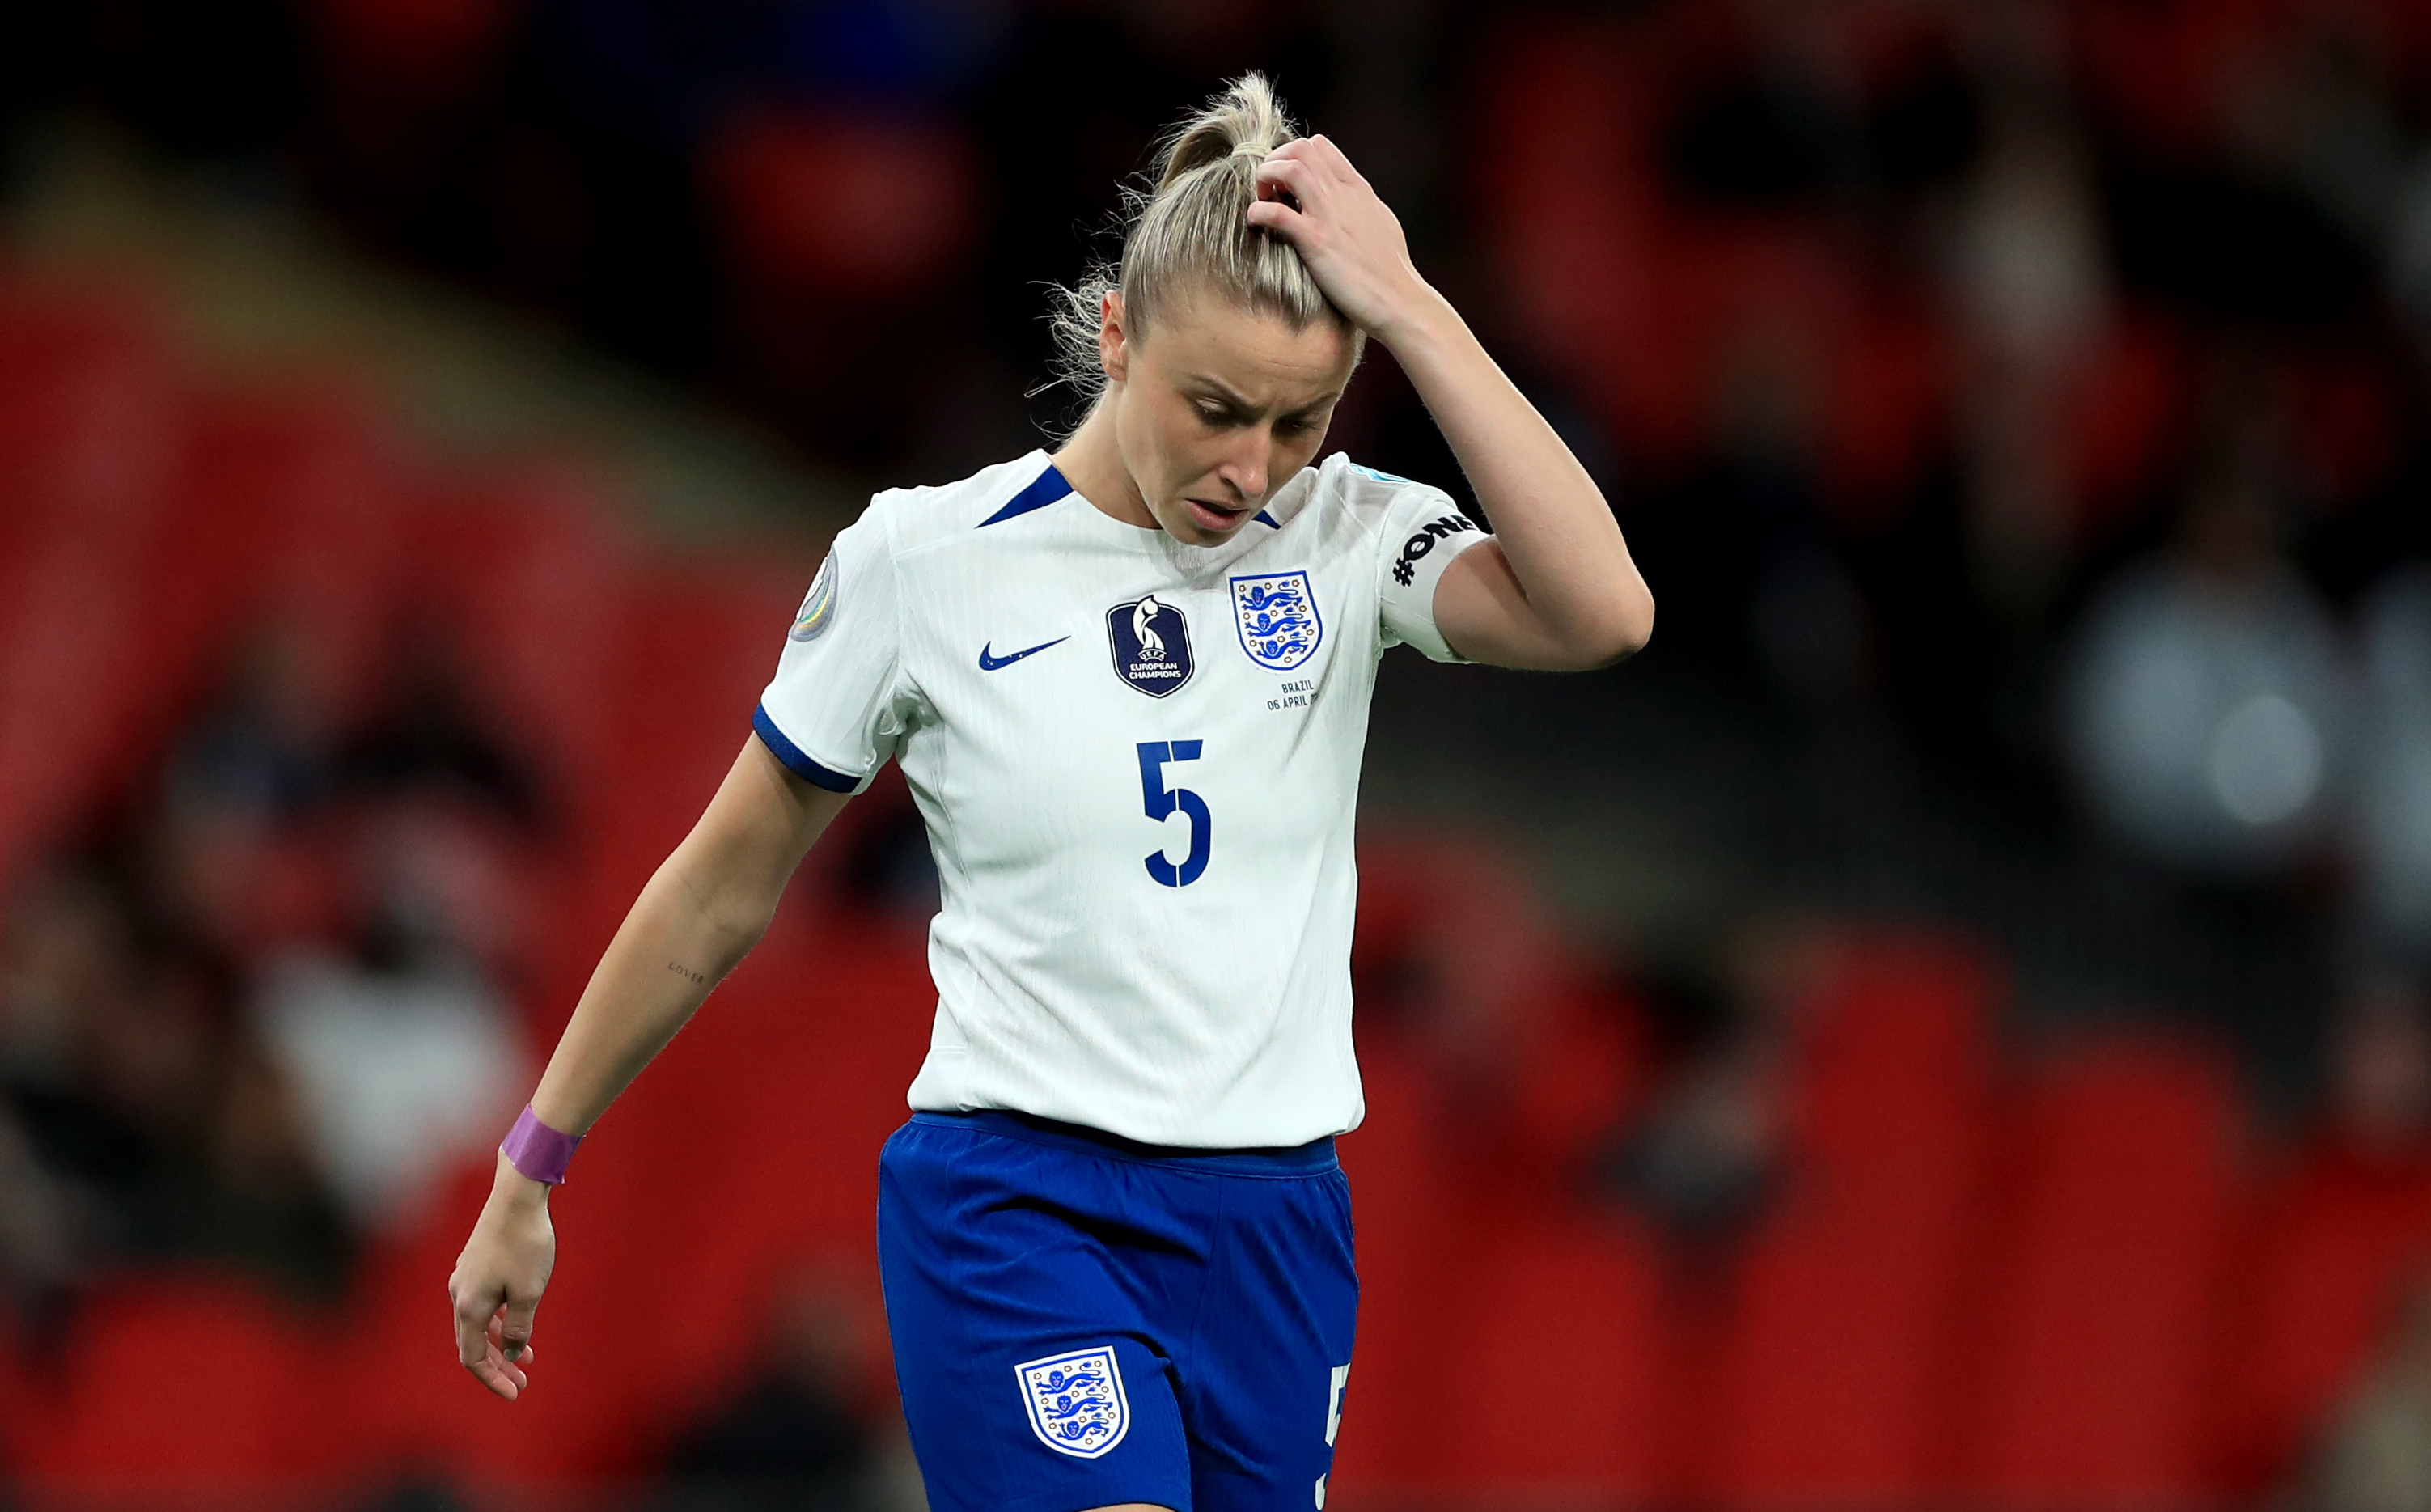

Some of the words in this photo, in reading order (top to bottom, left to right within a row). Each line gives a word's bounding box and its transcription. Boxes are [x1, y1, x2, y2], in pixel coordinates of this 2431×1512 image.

[1139, 650, 1166, 661] UEFA
[1129, 663, 1178, 671] EUROPEAN
[1129, 670, 1182, 680] CHAMPIONS
[1281, 679, 1315, 693] BRAZIL
[1267, 699, 1281, 710] 06
[1283, 695, 1308, 709] APRIL
[1136, 739, 1211, 887] 5
[668, 961, 704, 984] LOVER
